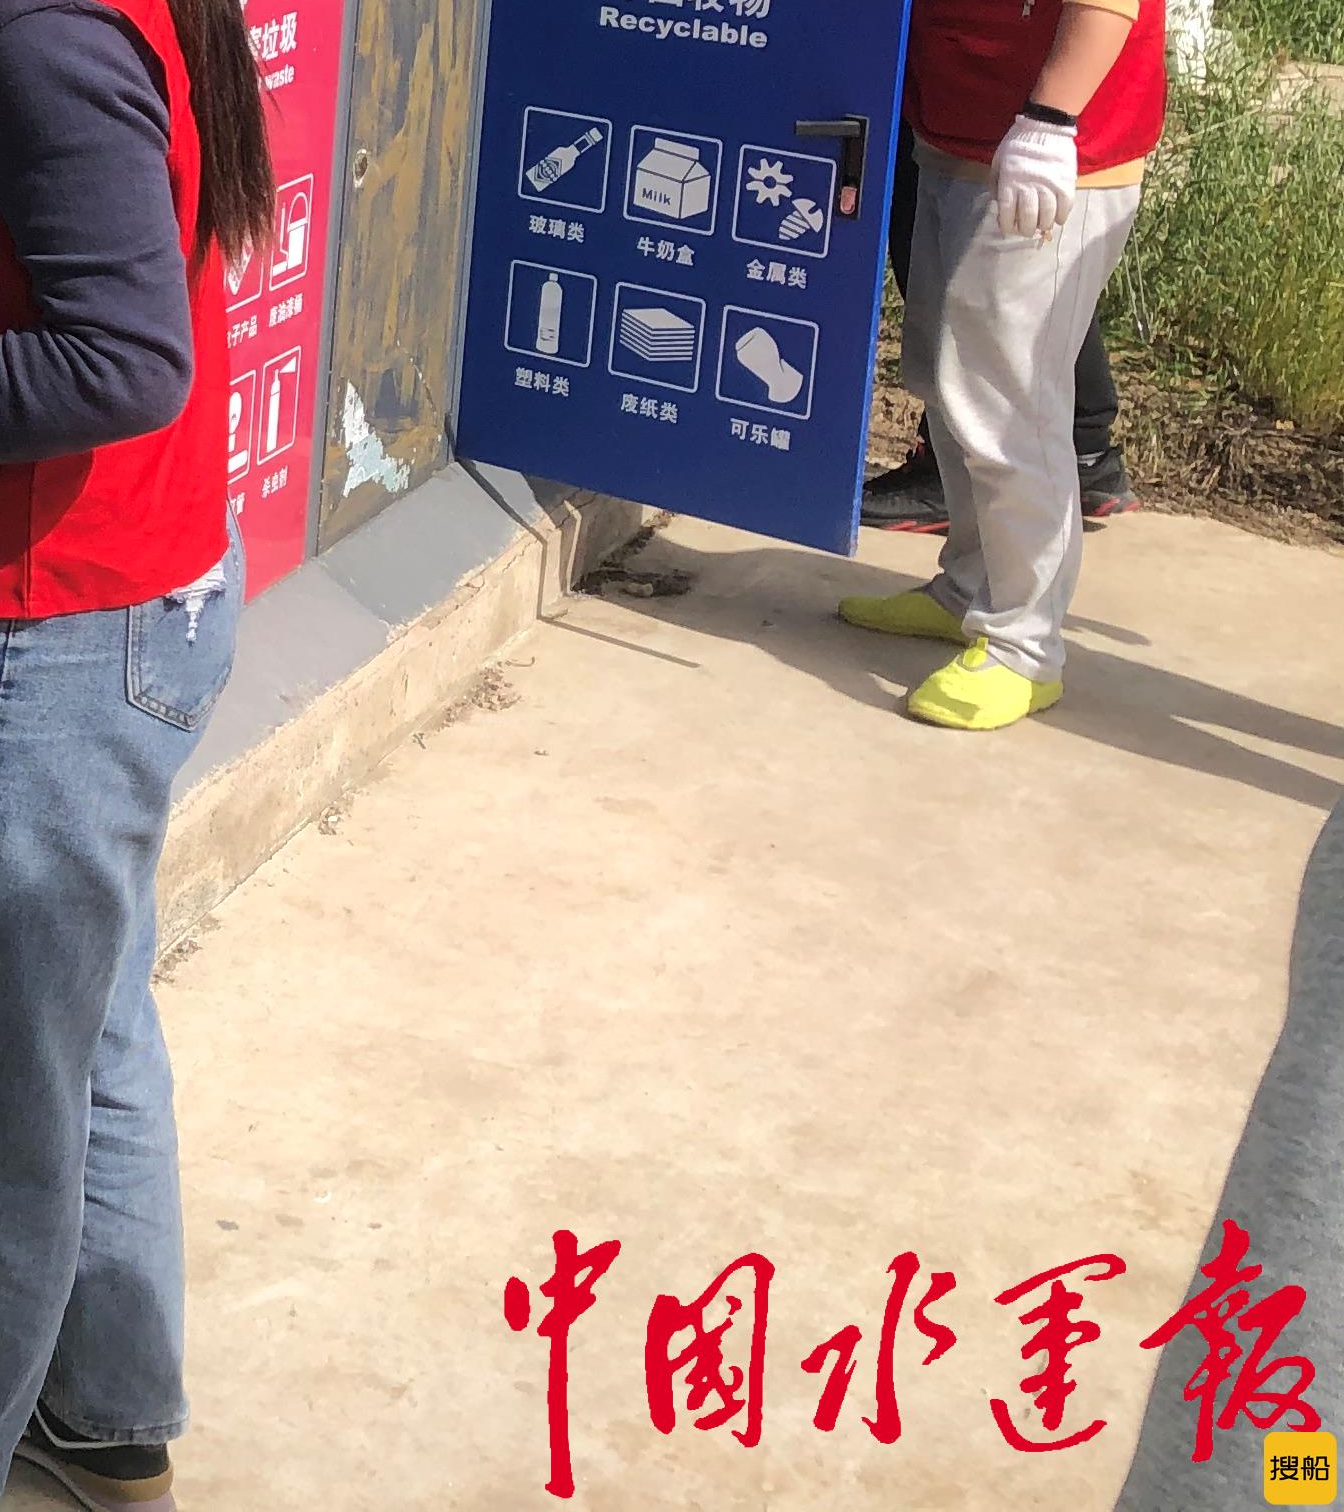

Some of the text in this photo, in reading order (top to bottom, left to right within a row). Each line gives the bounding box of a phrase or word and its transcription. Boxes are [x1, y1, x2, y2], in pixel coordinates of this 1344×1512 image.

[599, 6, 768, 48] Recyclable
[641, 187, 672, 206] Milk
[528, 215, 585, 243] 玻璃类
[636, 236, 695, 266] 牛奶盒
[746, 259, 807, 289] 金属类
[514, 366, 570, 397] 塑料类
[620, 393, 679, 423] 废纸类
[730, 417, 791, 451] 可乐罐
